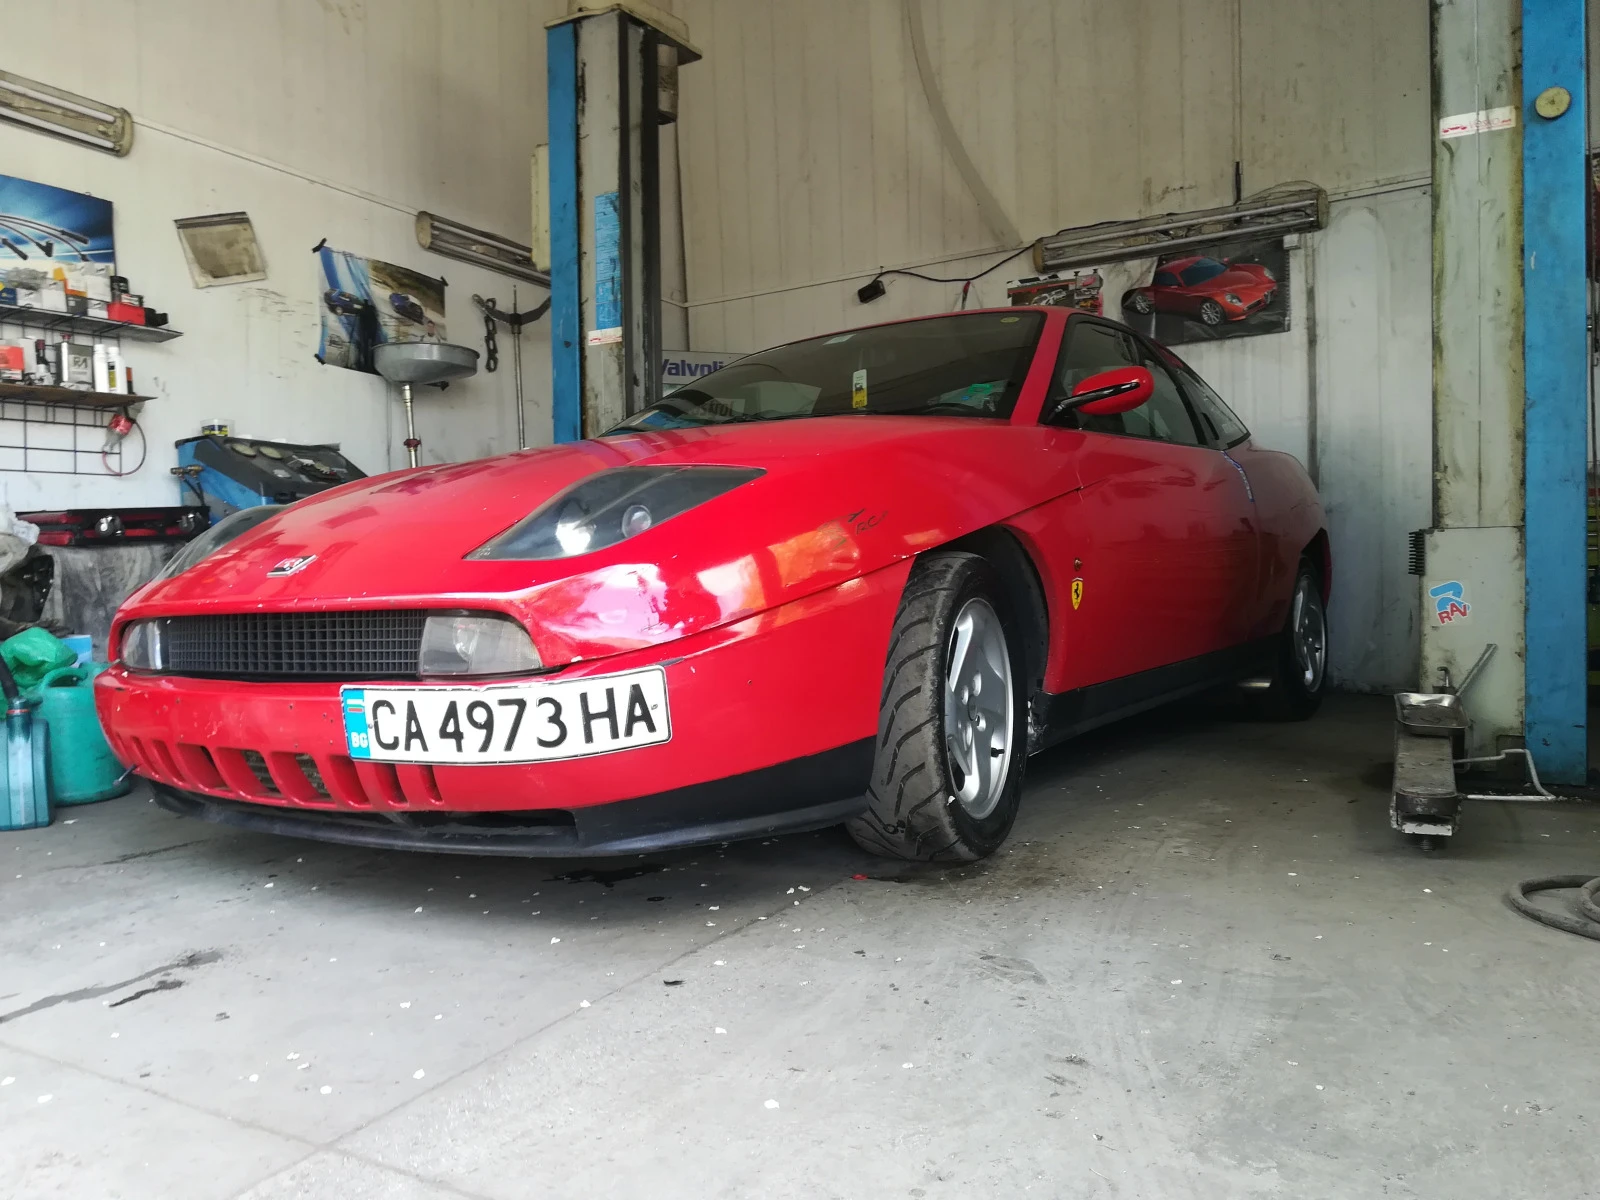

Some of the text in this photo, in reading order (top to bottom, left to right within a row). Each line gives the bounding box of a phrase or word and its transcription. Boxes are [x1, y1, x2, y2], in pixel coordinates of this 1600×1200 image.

[1437, 602, 1468, 625] RAV
[372, 683, 657, 753] CA 4973 HA
[351, 731, 369, 748] BG
